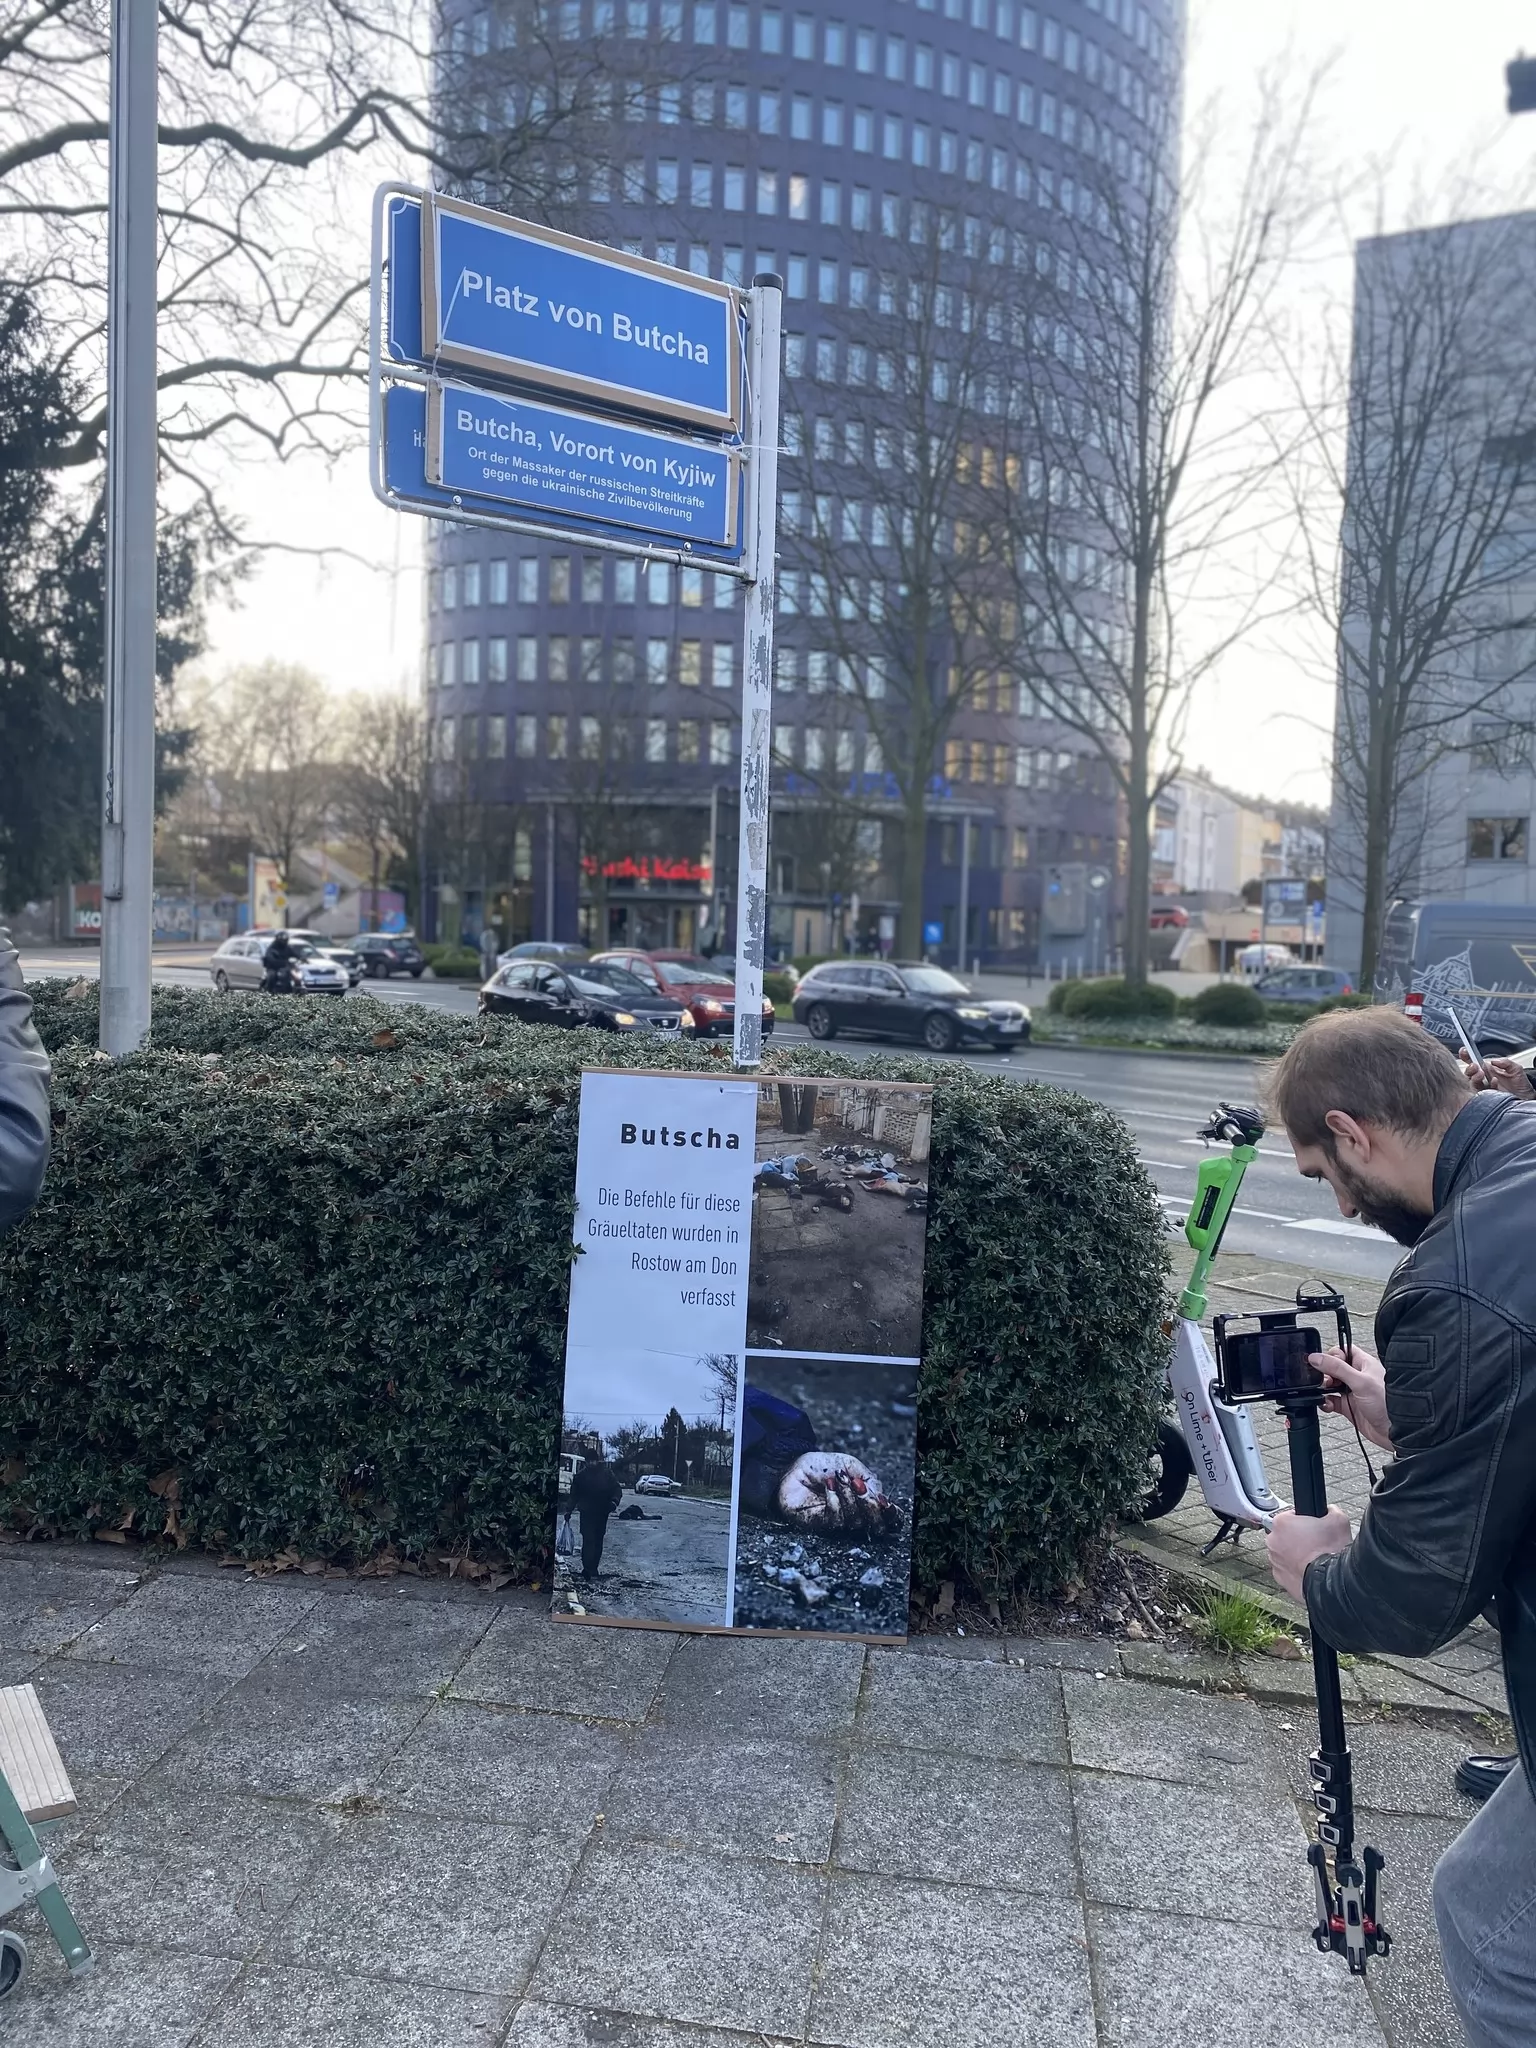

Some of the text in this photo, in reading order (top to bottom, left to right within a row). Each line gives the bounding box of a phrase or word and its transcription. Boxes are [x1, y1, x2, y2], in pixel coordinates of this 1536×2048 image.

[463, 268, 709, 365] Platz von Butcha
[457, 409, 716, 488] Butcha, Vorort von Kyjiw
[468, 446, 705, 508] Ort der Massaker der russischen Streitkräfte
[482, 467, 692, 522] gegen die ukrainische Zivilbevölkerung
[620, 1123, 740, 1150] Butscha
[598, 1187, 740, 1212] Die Befehle für diese
[588, 1218, 739, 1244] Gräueltaten wurden in
[631, 1252, 737, 1275] Rostow am Don
[680, 1287, 736, 1307] verfasst
[1189, 1411, 1204, 1441] Lime
[1202, 1450, 1218, 1483] Uber
